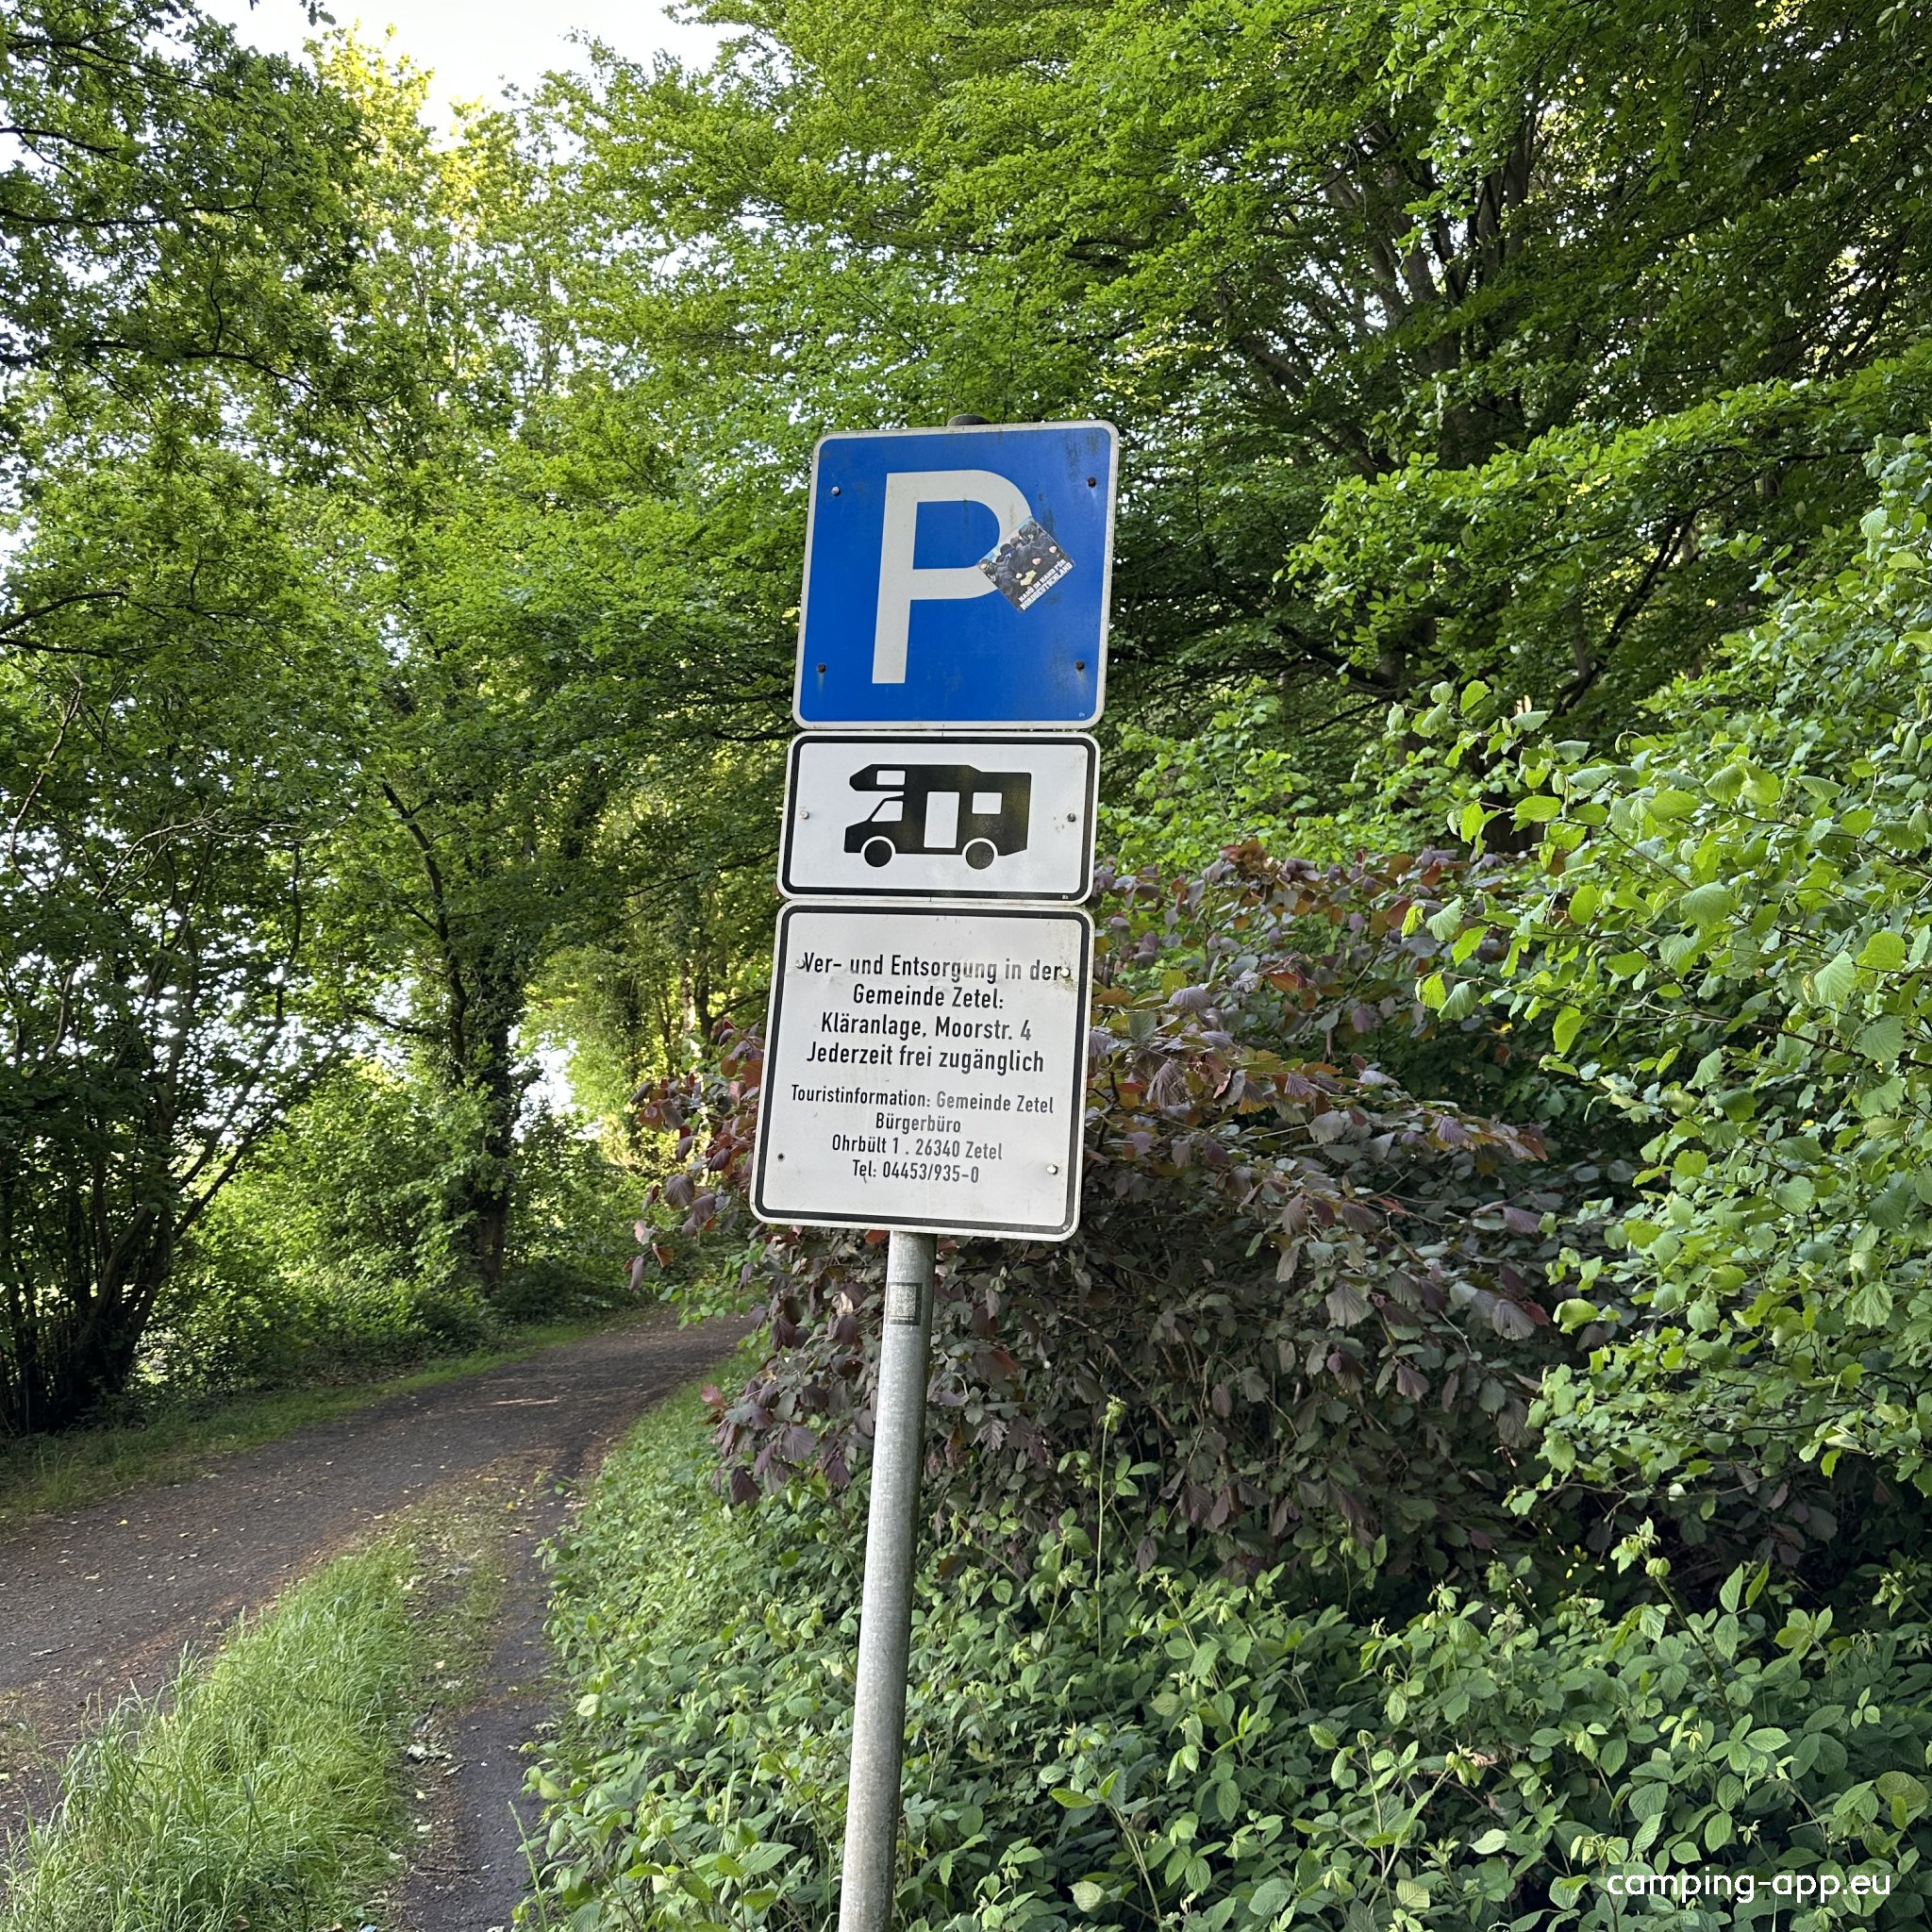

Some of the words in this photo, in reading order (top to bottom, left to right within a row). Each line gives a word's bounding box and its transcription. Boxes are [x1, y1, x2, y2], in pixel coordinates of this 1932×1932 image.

[872, 469, 1034, 684] P
[1020, 561, 1074, 610] NORDDEUTSCHLAND
[1040, 568, 1056, 583] HAND
[803, 952, 842, 974] Ver-
[849, 954, 884, 975] und
[891, 955, 997, 984] Entsorgung
[1005, 958, 1022, 980] in
[1029, 959, 1062, 981] der
[853, 983, 945, 1007] Gemeinde
[951, 987, 1004, 1009] Zetel:
[821, 1011, 927, 1041] Kläranlage,
[935, 1016, 1013, 1041] Moorstr.
[1020, 1020, 1032, 1041] 4
[806, 1041, 893, 1066] Jederzeit
[898, 1044, 932, 1068] frei
[938, 1049, 1044, 1076] zugänglich
[791, 1084, 931, 1108] Touristinformation:
[936, 1091, 1011, 1112] Gemeinde
[1016, 1094, 1054, 1114] Zetel
[875, 1112, 961, 1135] Bürgerbüro
[831, 1134, 887, 1154] Ohrbült
[892, 1137, 899, 1154] 1
[915, 1139, 960, 1158] 26340
[965, 1141, 1003, 1160] Zetel
[852, 1159, 877, 1178] Tel:
[882, 1160, 979, 1183] 04453/935-0
